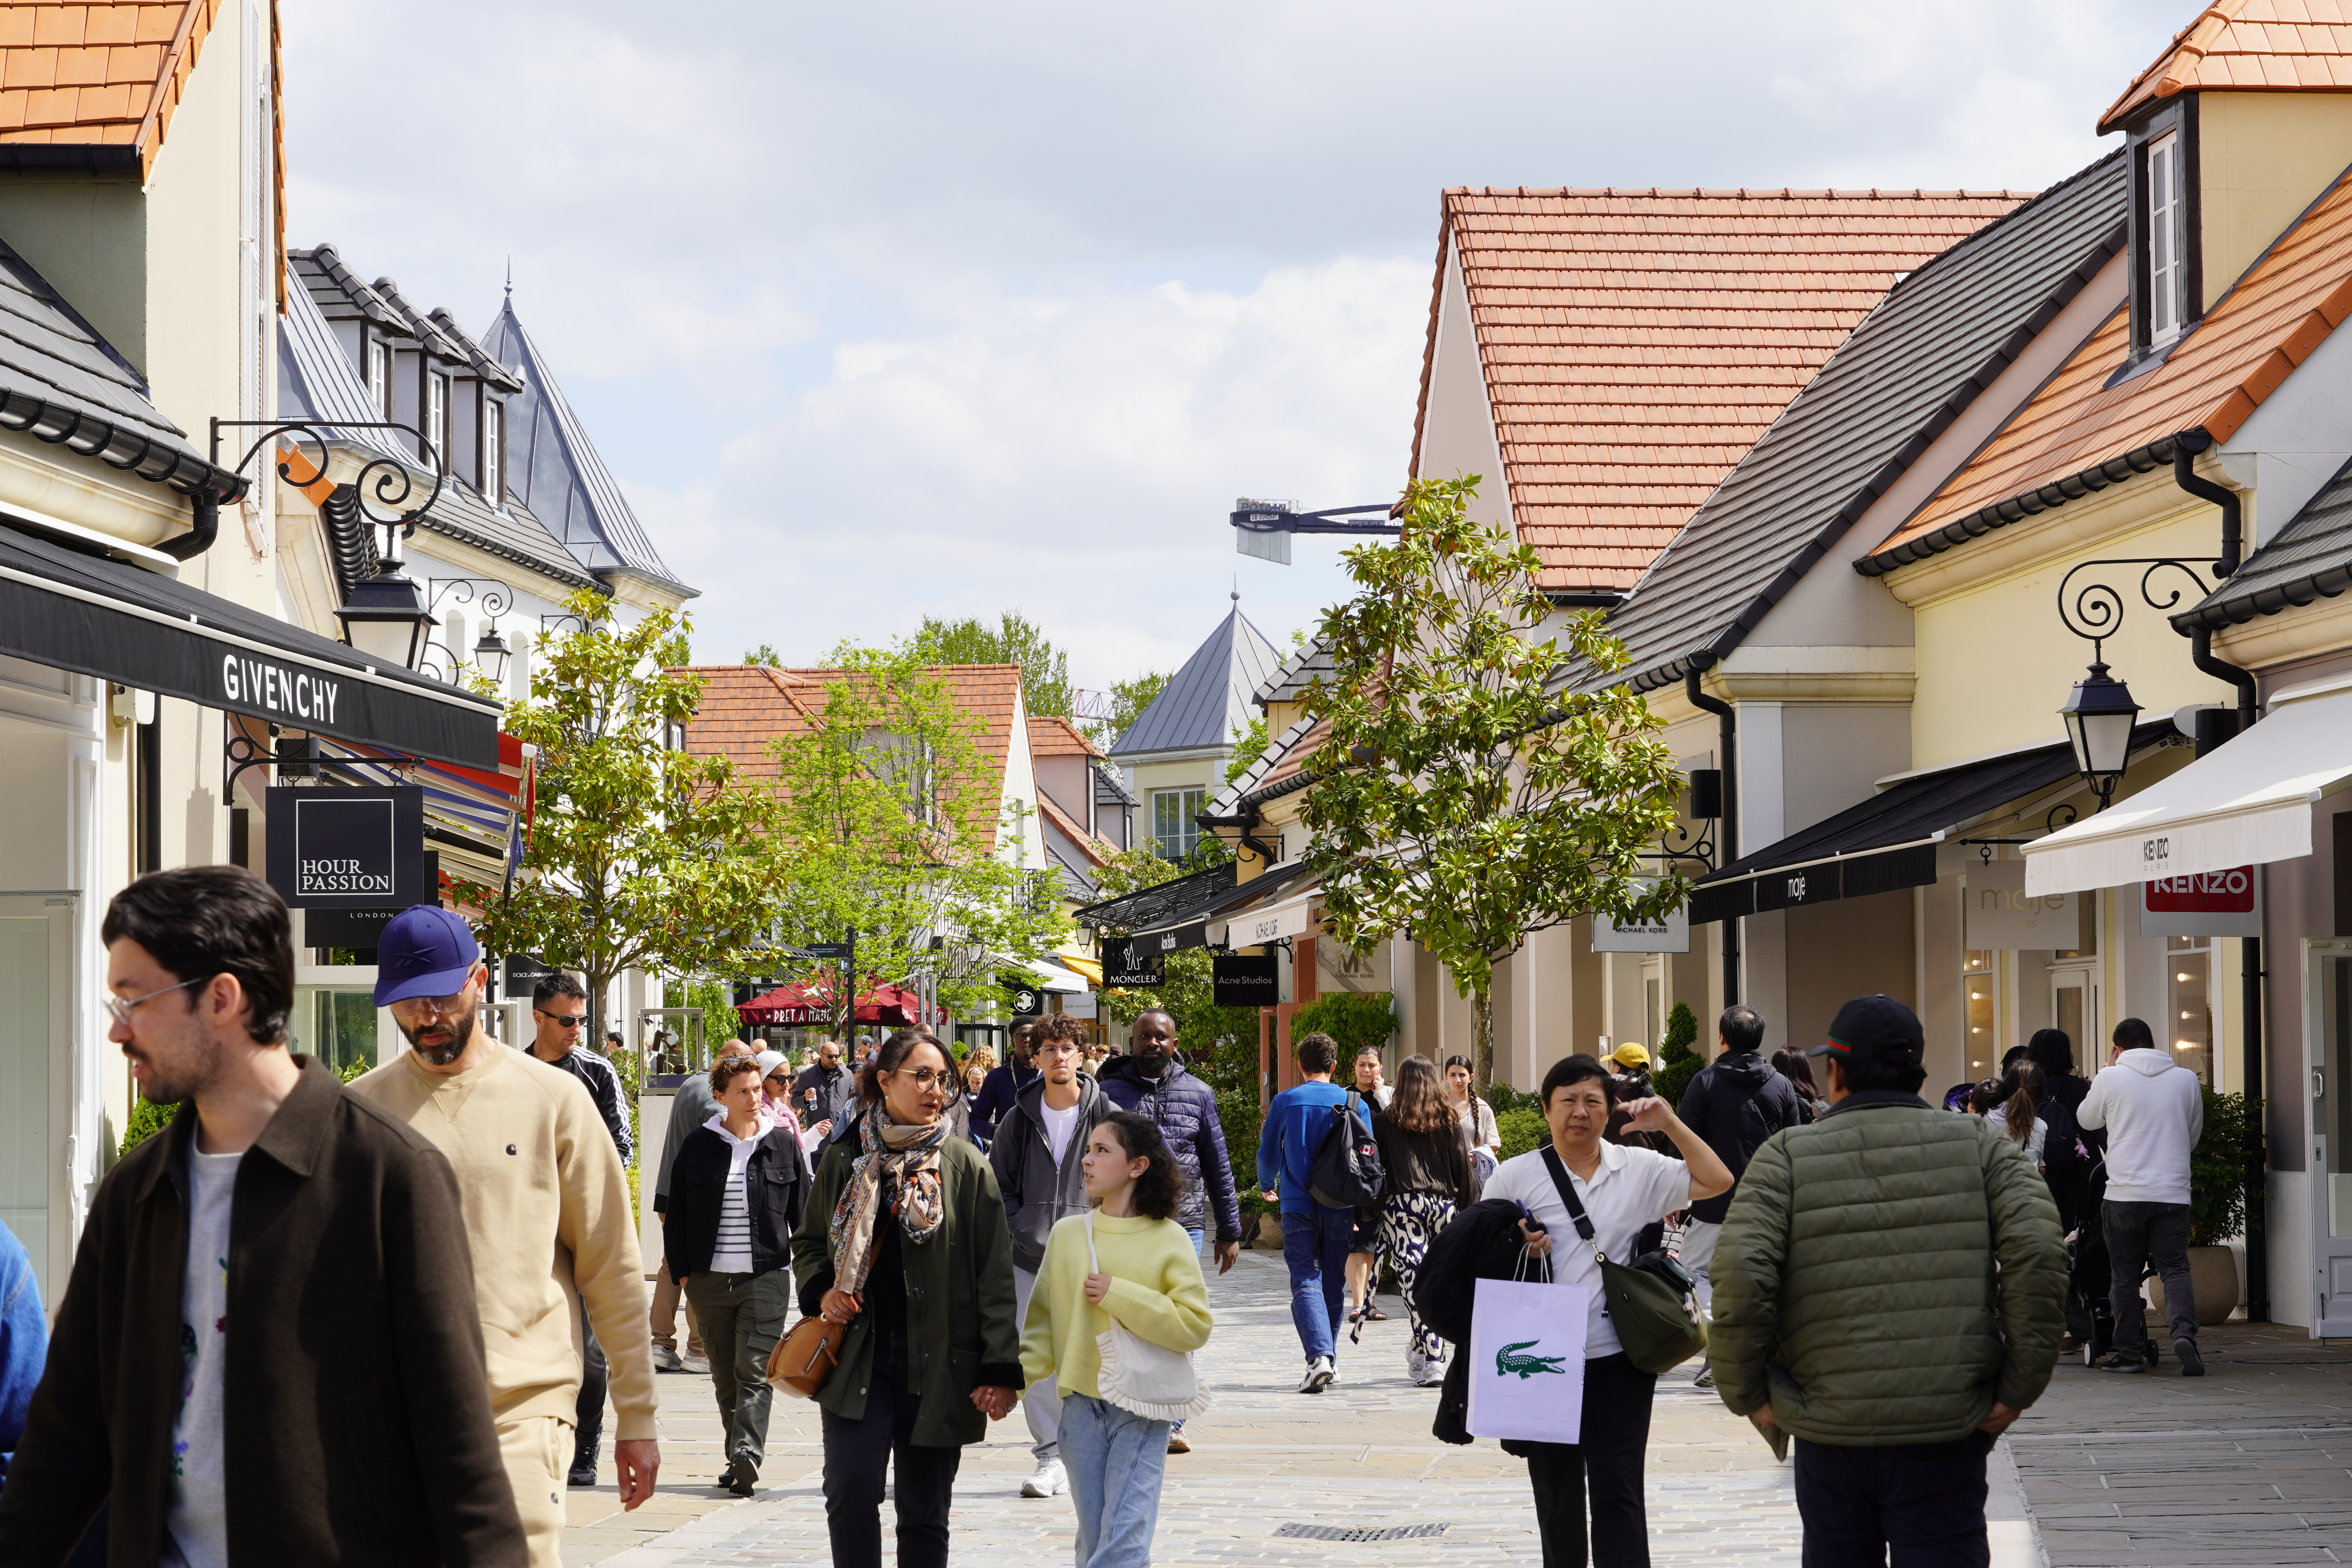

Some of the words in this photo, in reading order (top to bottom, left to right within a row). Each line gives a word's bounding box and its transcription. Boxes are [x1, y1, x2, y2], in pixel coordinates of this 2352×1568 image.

[1241, 503, 1286, 512] POTAIN
[224, 655, 338, 724] GIVENCHY
[2144, 837, 2169, 862] KENZO
[302, 860, 363, 874] HOUR
[2144, 862, 2169, 873] PARIS
[302, 875, 388, 890] PASSION
[1788, 872, 1806, 901] maje
[2154, 871, 2248, 894] KENZO
[1981, 889, 2065, 915] maje
[2154, 897, 2245, 906] PARIS
[1110, 975, 1157, 984] MONCLER
[1218, 976, 1240, 984] Acne
[1242, 976, 1272, 984] Studios
[774, 1009, 796, 1023] PRET
[799, 1009, 804, 1022] A
